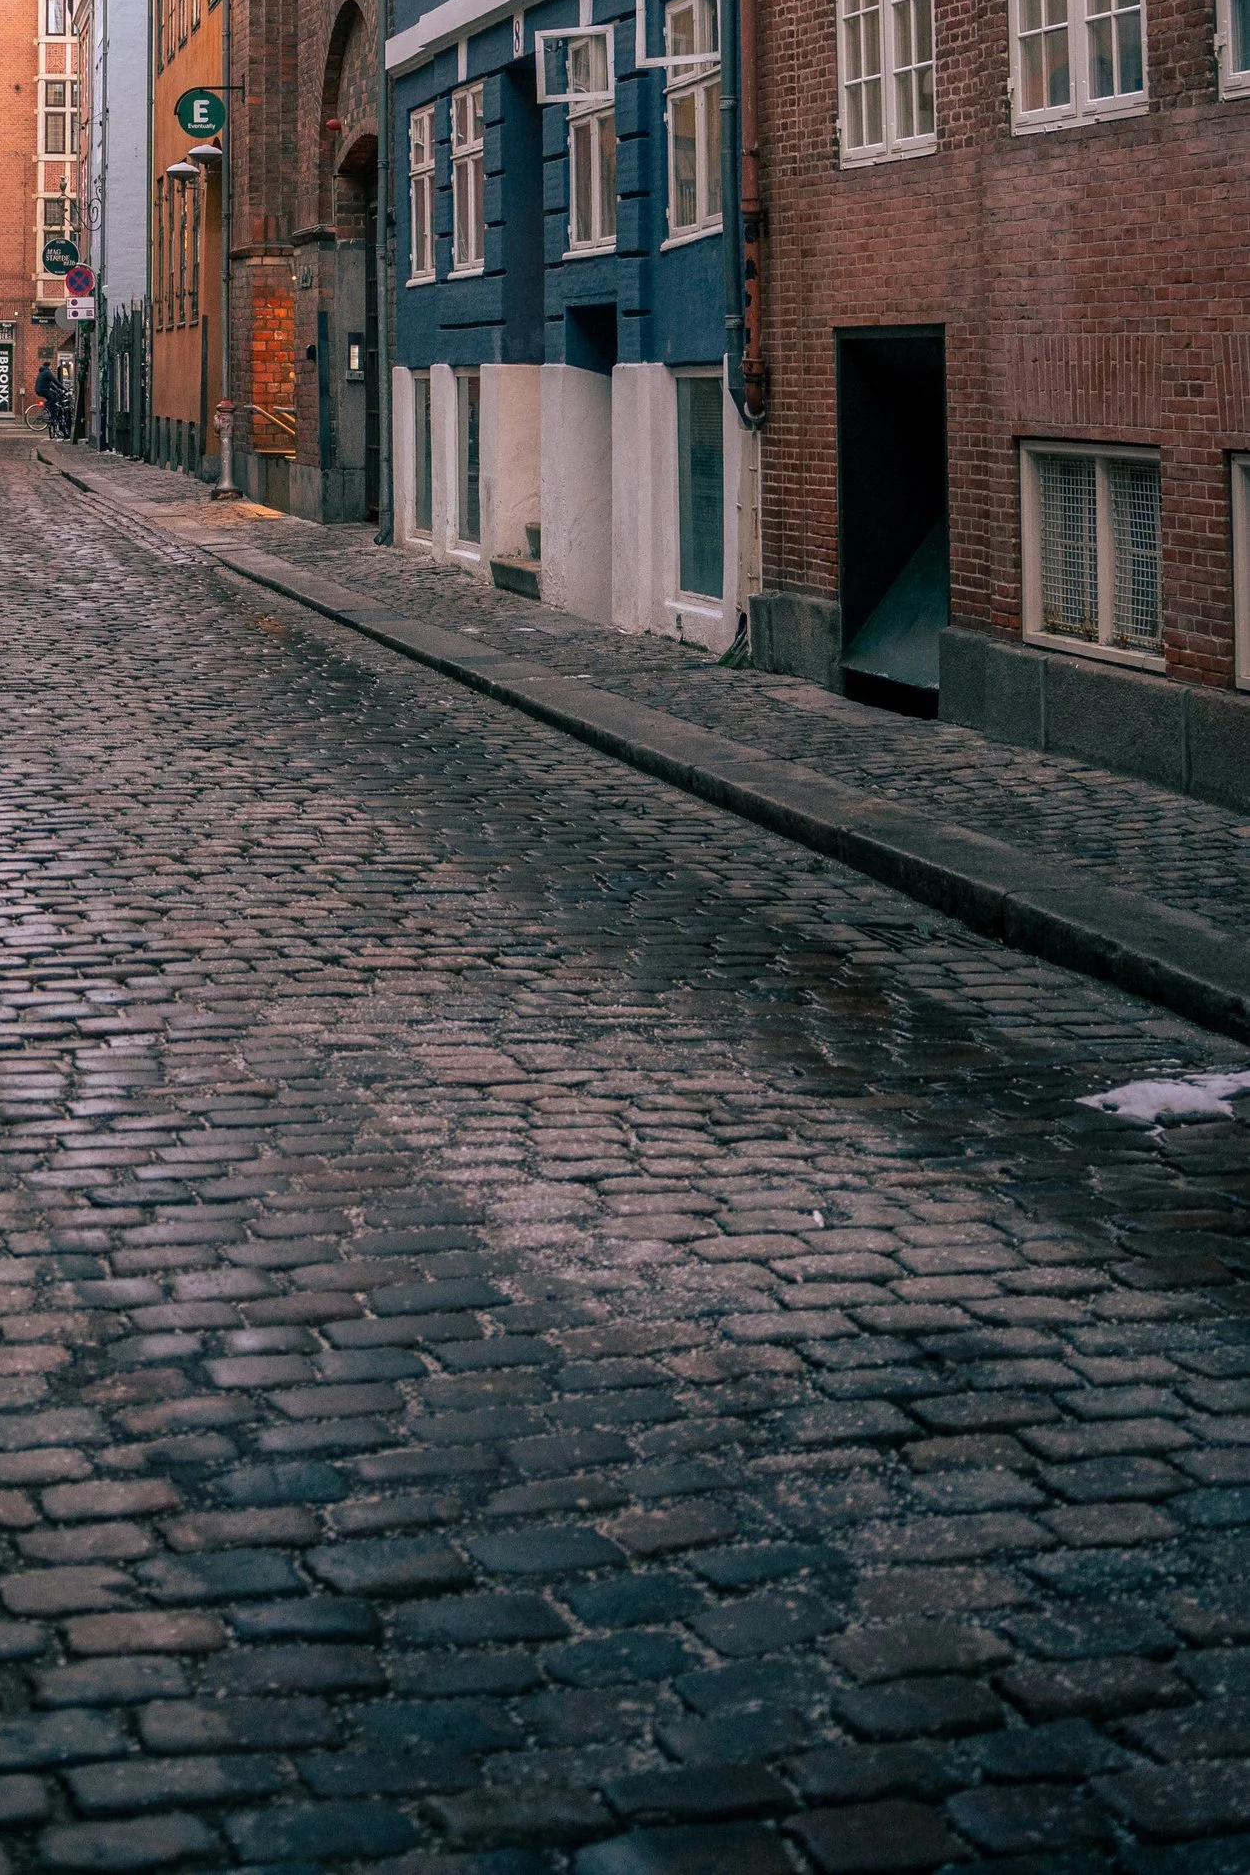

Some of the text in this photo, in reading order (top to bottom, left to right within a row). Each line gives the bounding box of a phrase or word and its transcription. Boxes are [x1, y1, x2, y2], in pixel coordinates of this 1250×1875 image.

[515, 20, 520, 53] 8
[193, 99, 210, 123] E
[0, 356, 9, 403] BRONX
